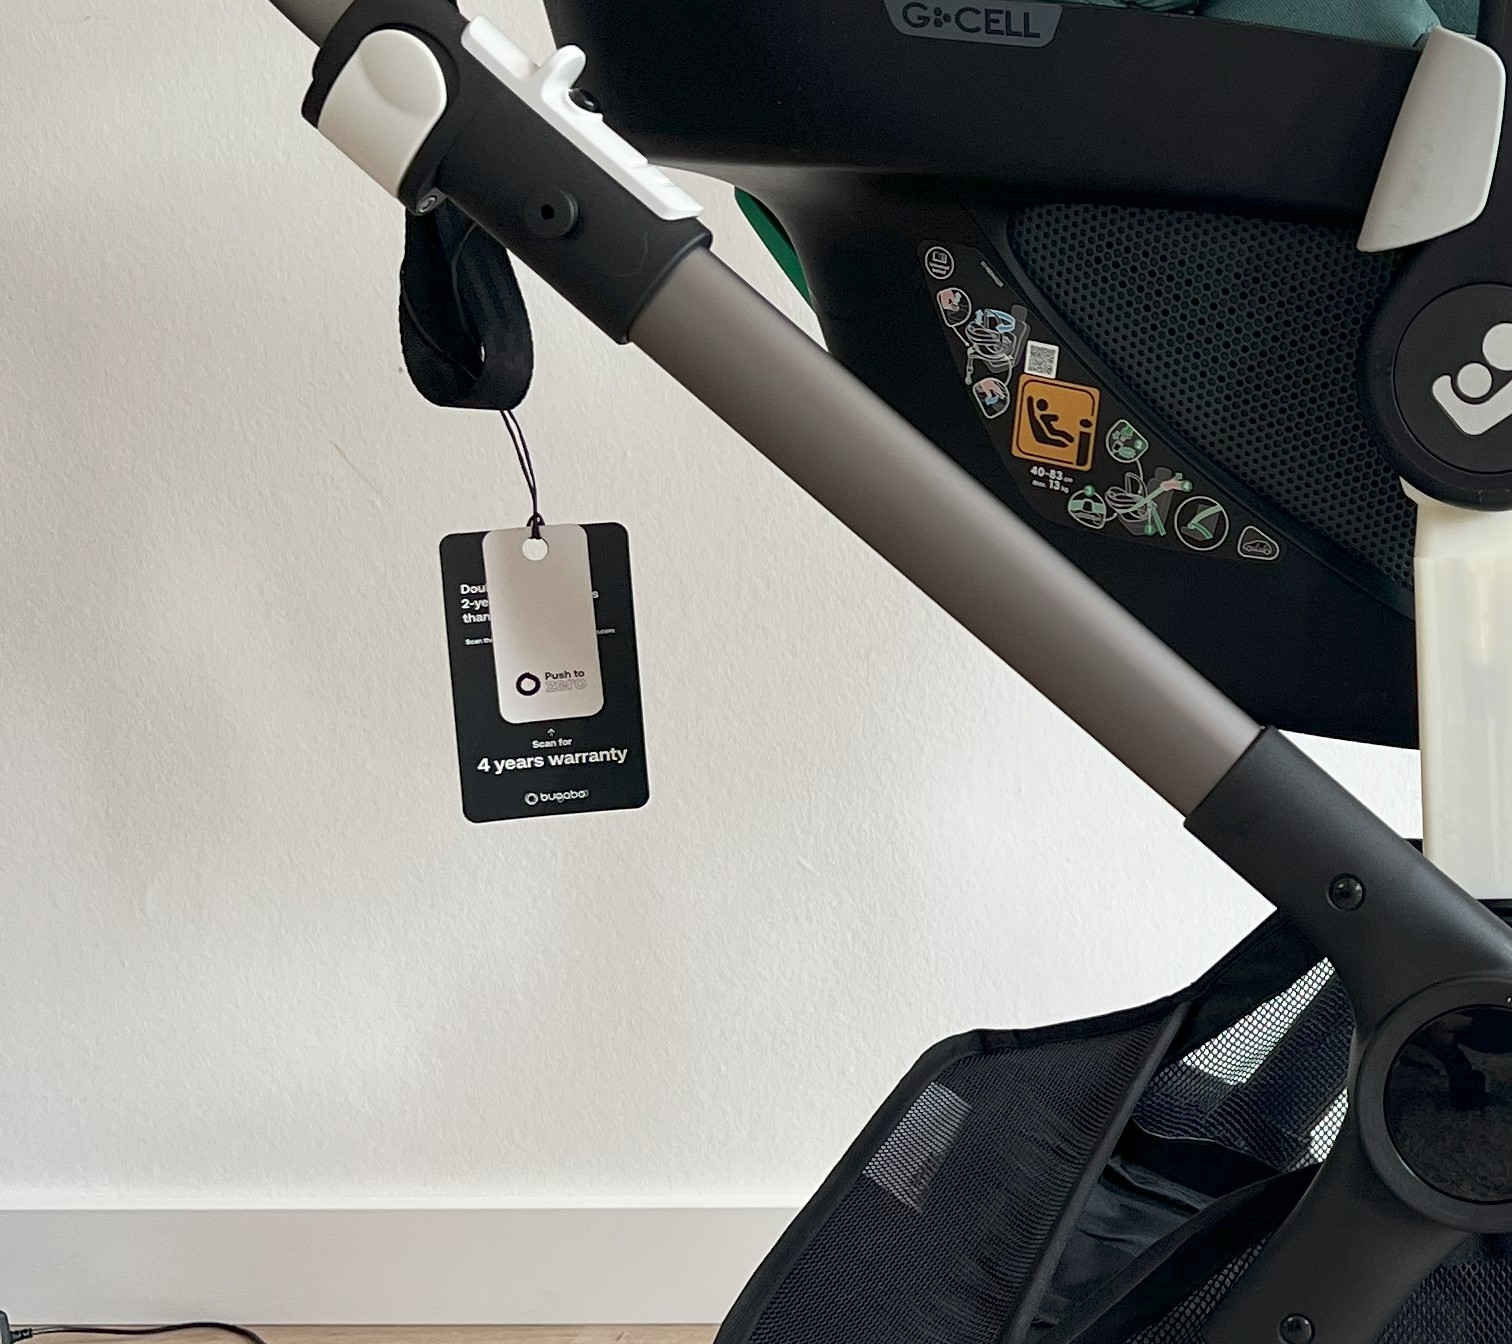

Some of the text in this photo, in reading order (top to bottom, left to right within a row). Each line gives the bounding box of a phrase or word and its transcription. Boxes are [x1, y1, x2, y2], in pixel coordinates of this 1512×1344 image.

[1030, 466, 1063, 480] 40-83
[545, 669, 585, 680] Push to
[545, 678, 588, 693] zero
[532, 737, 573, 749] Scan for
[477, 747, 628, 775] 4 years warranty
